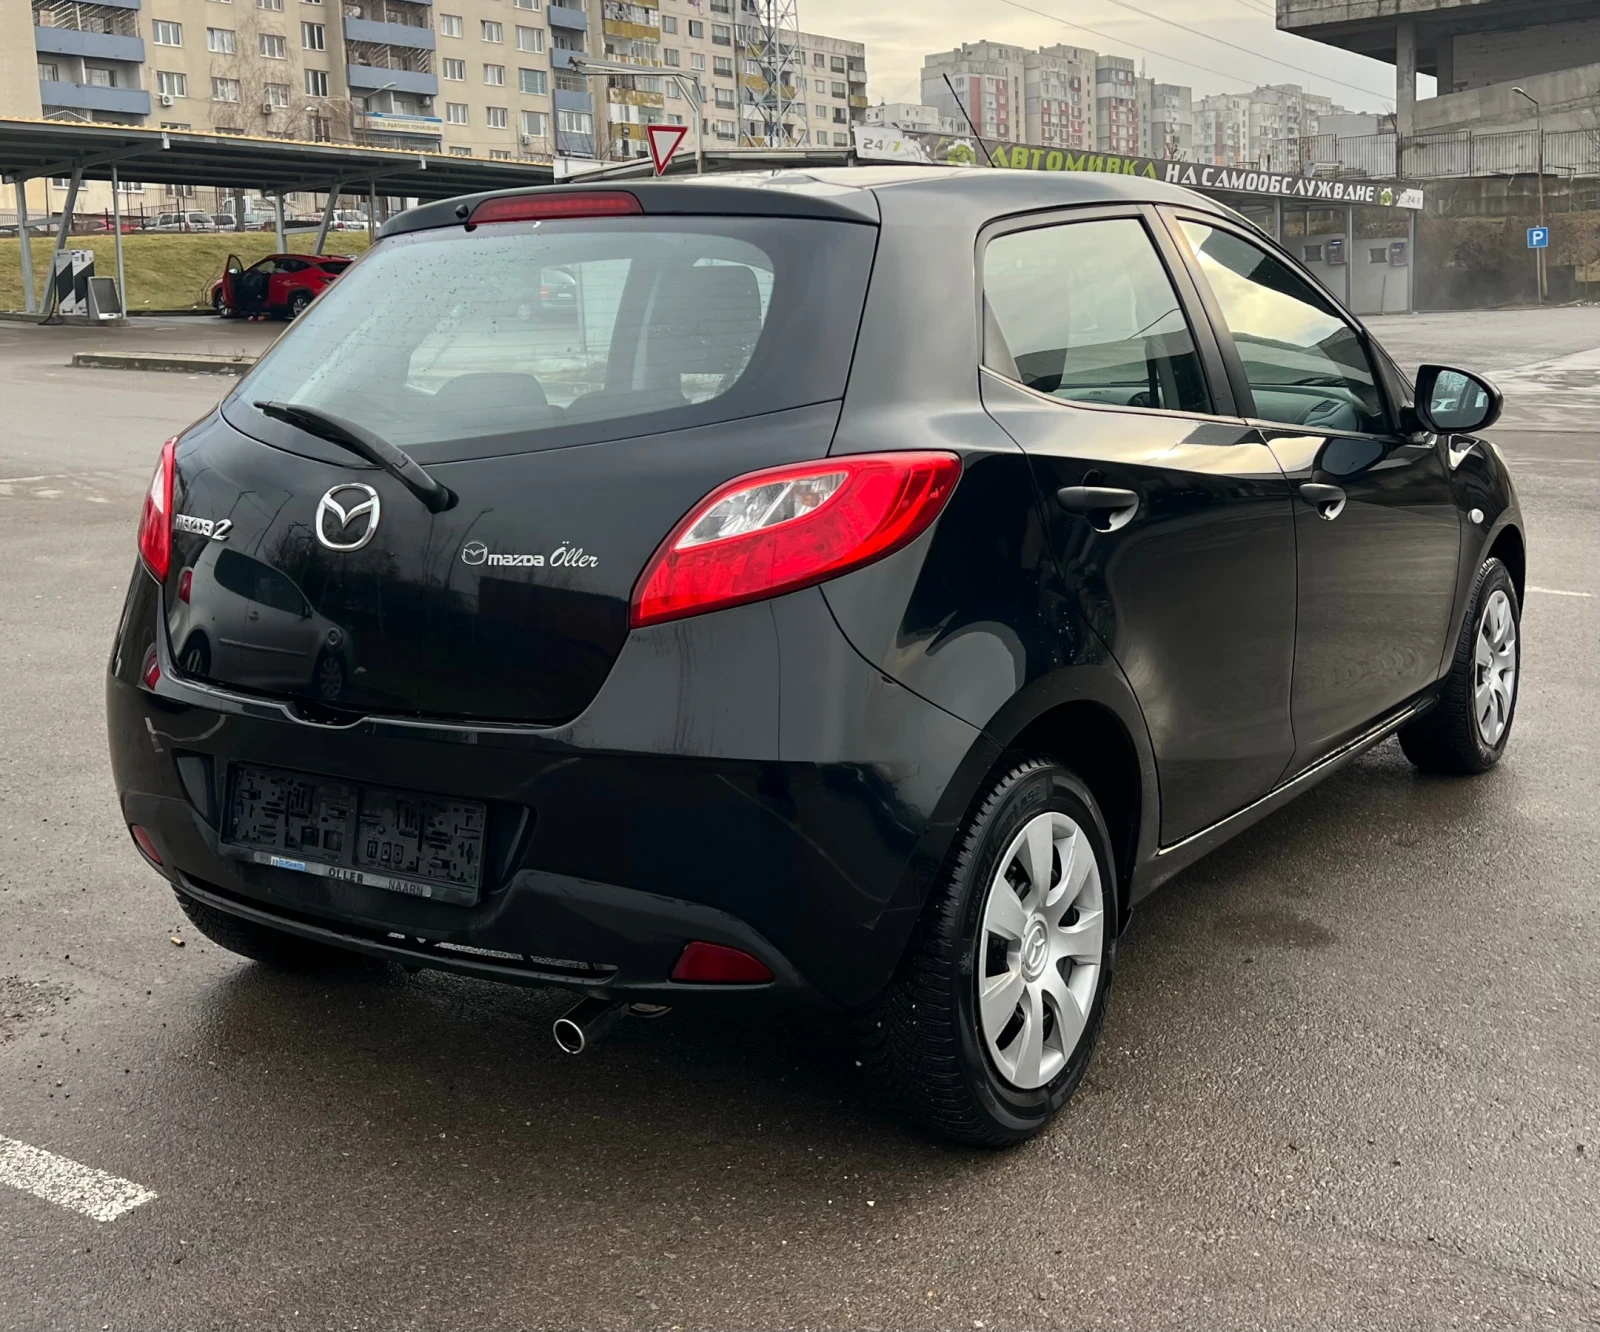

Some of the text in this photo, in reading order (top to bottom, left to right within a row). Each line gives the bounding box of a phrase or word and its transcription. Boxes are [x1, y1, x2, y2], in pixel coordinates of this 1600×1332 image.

[863, 137, 901, 152] 24/7
[985, 145, 1375, 202] АВТОМИВКА НА САМООБСЛУЖВАНЕ
[1532, 230, 1544, 245] P
[550, 541, 599, 568] Öller
[388, 880, 424, 897] NAARN
